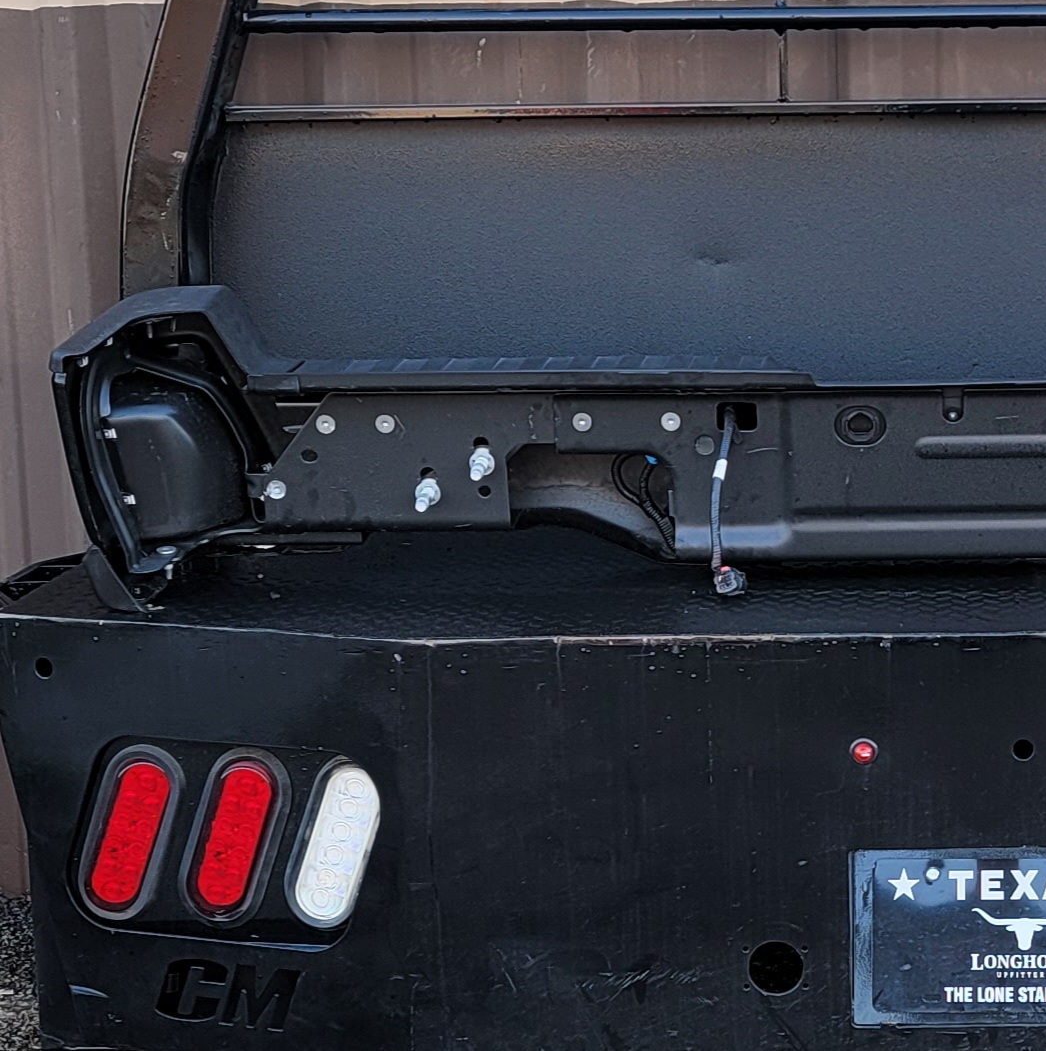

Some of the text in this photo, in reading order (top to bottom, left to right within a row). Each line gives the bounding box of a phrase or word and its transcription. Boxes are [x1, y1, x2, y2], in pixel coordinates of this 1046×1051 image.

[154, 958, 301, 1033] CM
[944, 986, 973, 1003] THE
[977, 986, 1014, 1003] LONE
